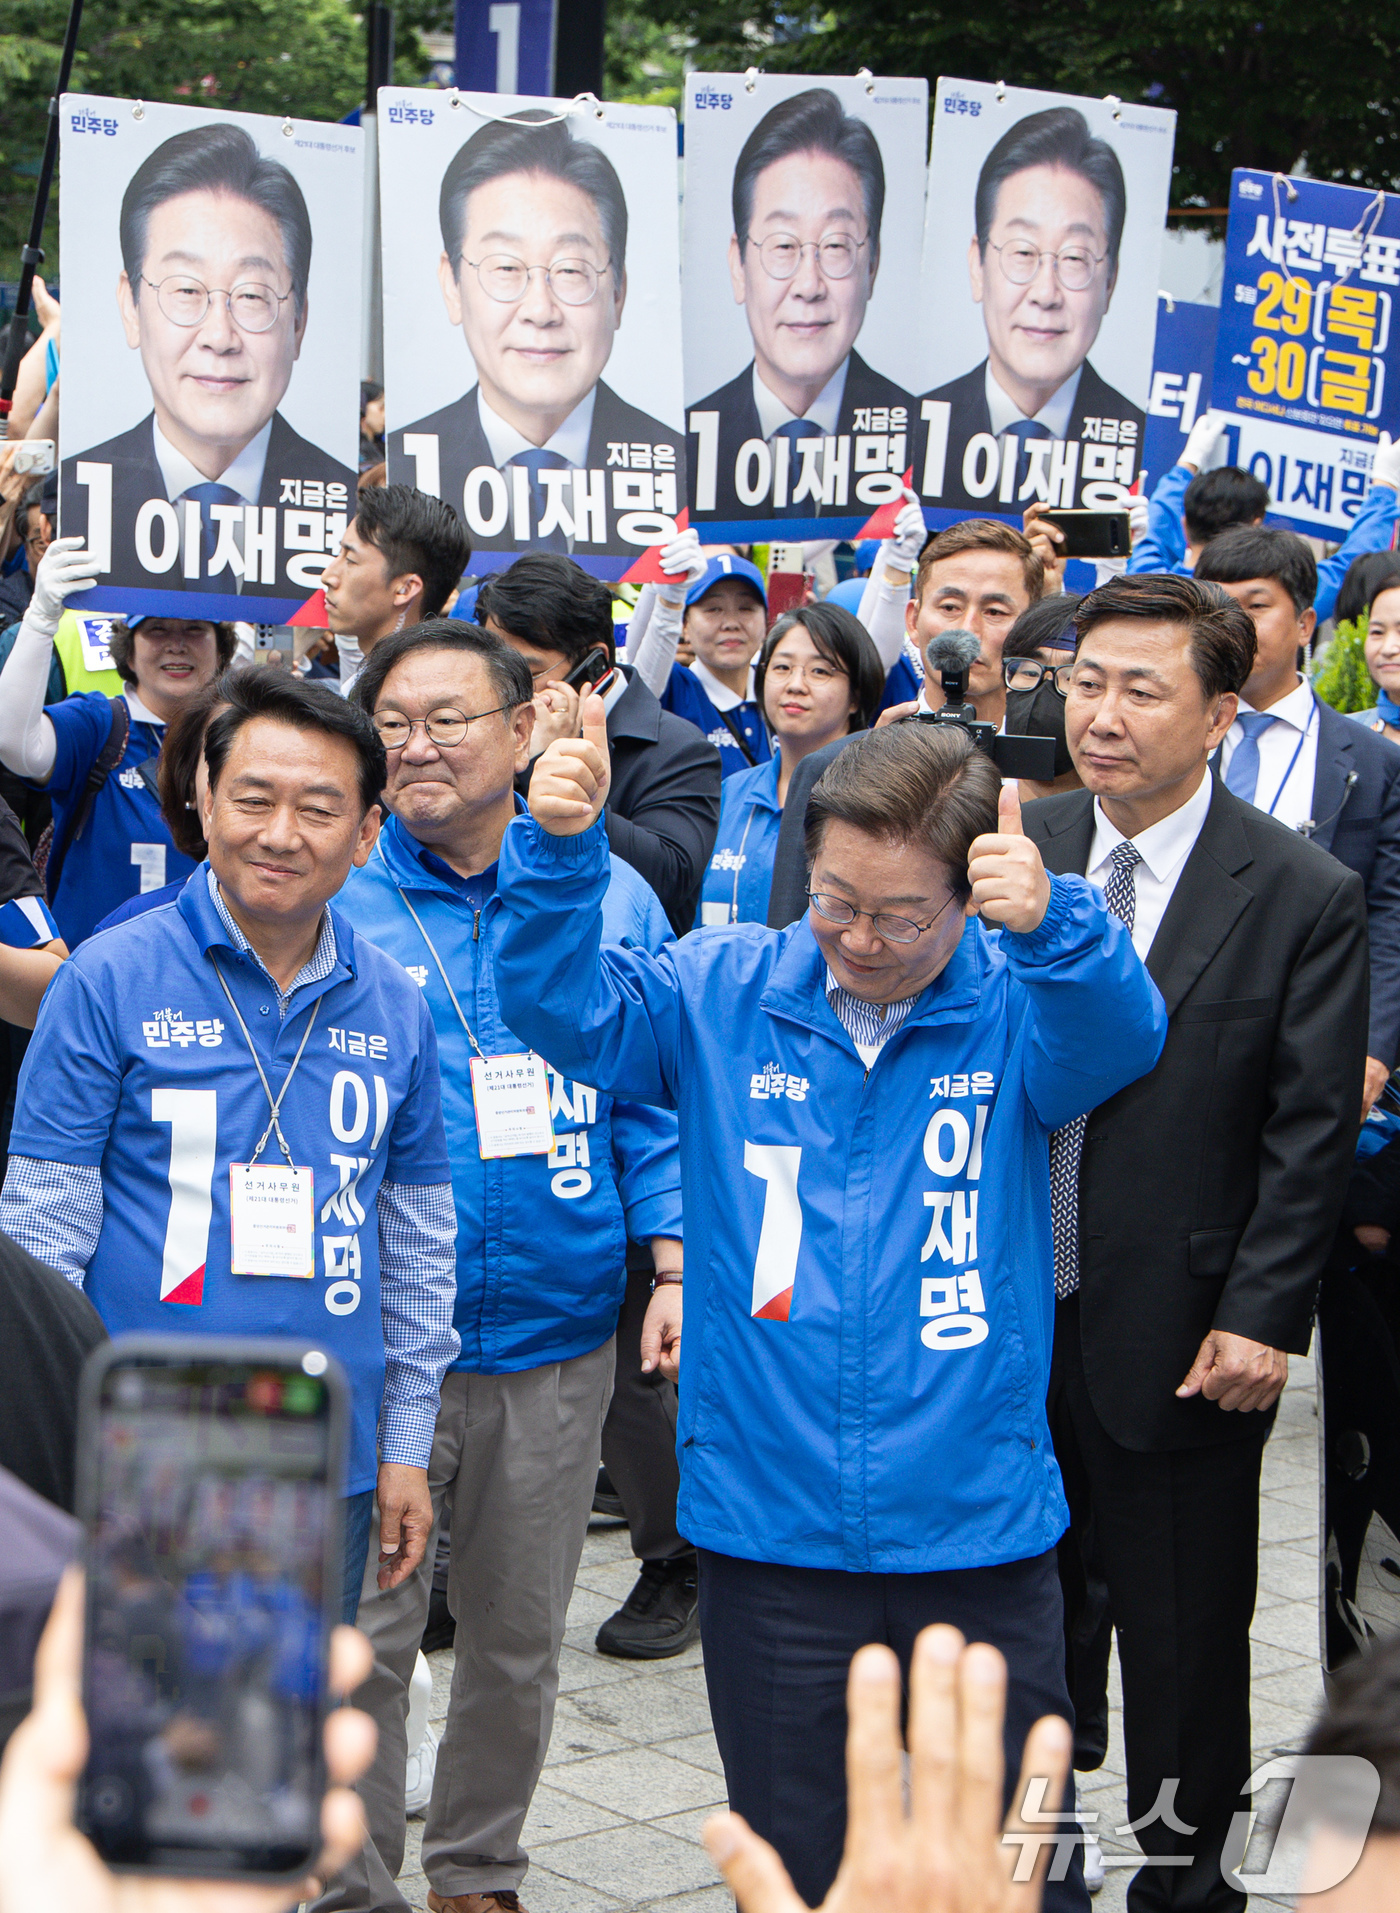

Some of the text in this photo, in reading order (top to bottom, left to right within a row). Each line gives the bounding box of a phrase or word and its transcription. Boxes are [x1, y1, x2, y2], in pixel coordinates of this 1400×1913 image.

[489, 3, 520, 94] 1
[388, 107, 435, 125] 민주당
[695, 93, 733, 110] 민주당
[944, 98, 982, 117] 민주당
[71, 115, 119, 136] 민주당
[1246, 214, 1400, 286] 사전투표
[852, 406, 908, 432] 지금은
[1081, 416, 1138, 445] 지금은
[606, 442, 676, 470] 지금은
[689, 410, 907, 511] 1 이재명
[920, 399, 1136, 510] 1 이재명
[279, 478, 348, 510] 지금은
[403, 433, 678, 546] 1 이재명
[76, 461, 348, 590] 1 이재명
[717, 554, 733, 574] 1
[142, 1018, 225, 1048] 민주당
[327, 1027, 389, 1060] 지금은
[750, 1073, 810, 1101] 민주당
[929, 1071, 995, 1099] 지금은
[151, 1088, 217, 1306] 1
[743, 1139, 803, 1322] 1
[920, 1105, 989, 1350] 이재명
